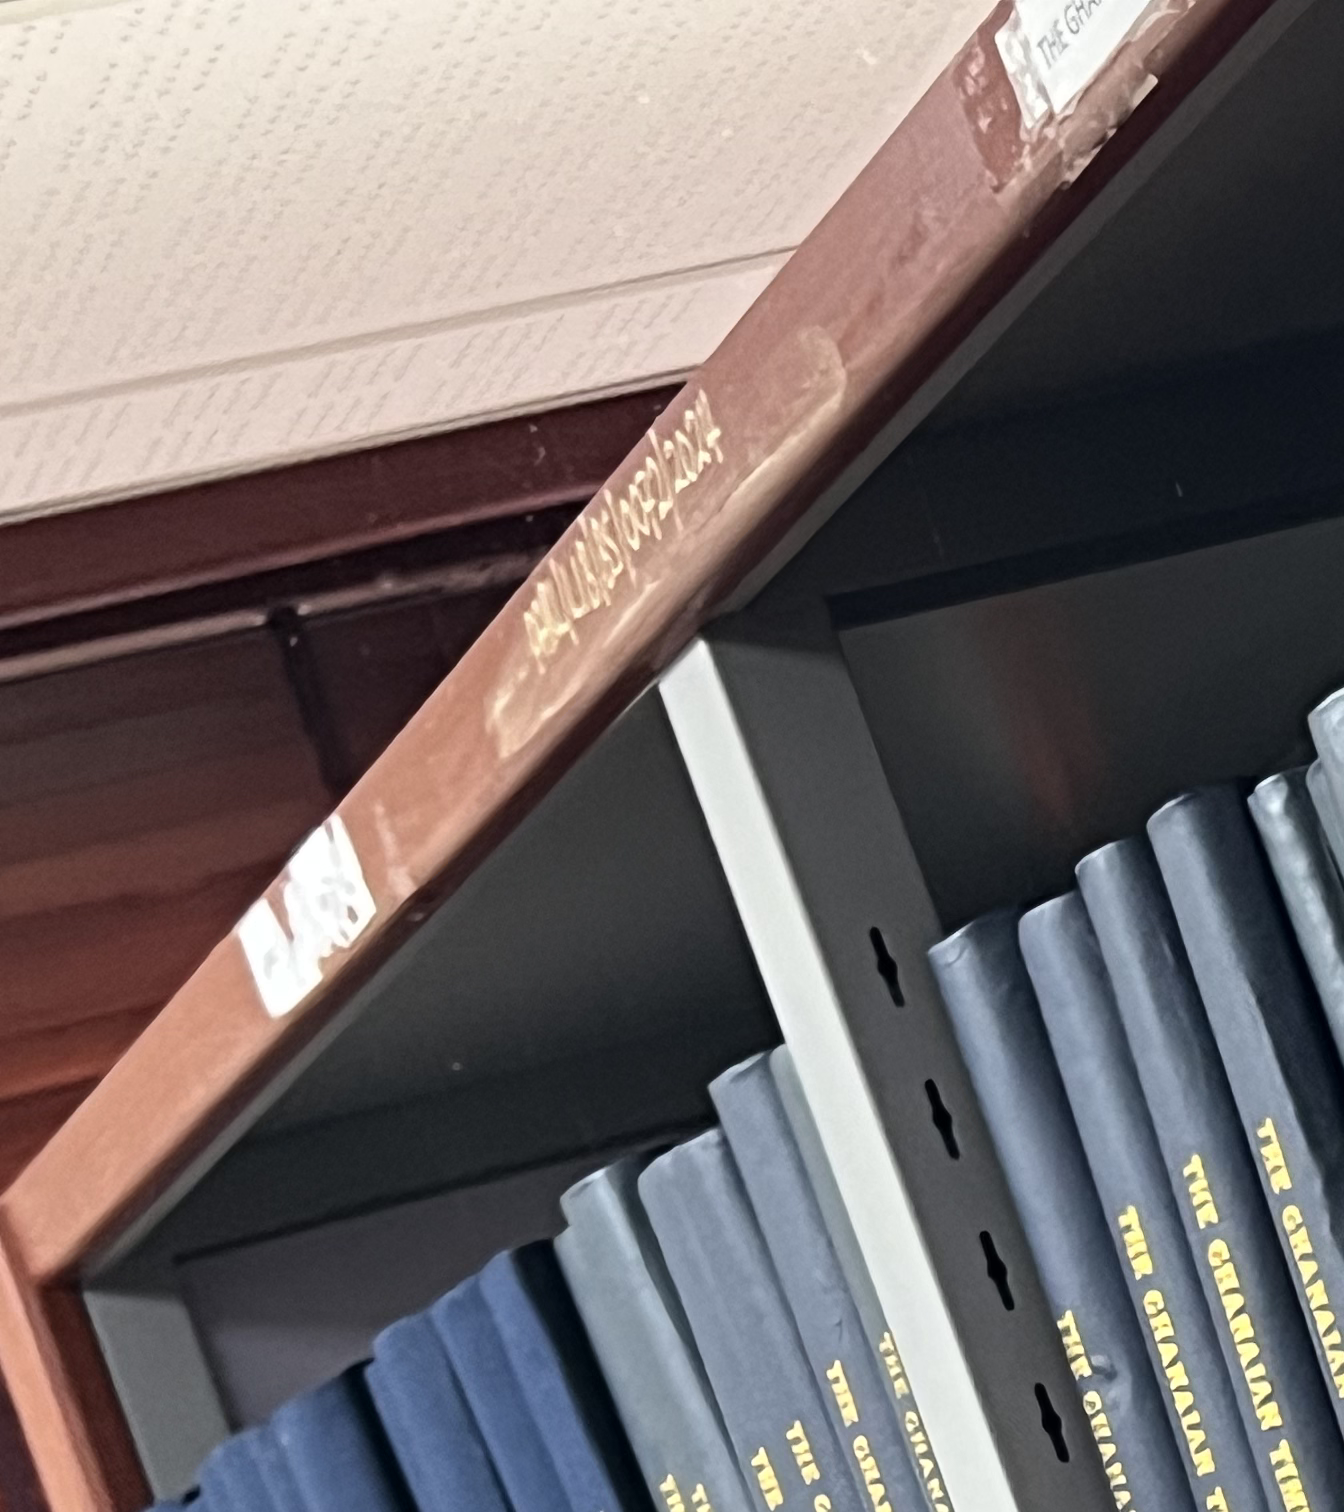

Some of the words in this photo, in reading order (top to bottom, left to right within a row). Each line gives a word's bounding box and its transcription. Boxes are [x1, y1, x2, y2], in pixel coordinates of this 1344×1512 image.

[1256, 1116, 1292, 1194] THE
[1117, 1204, 1154, 1280] THE
[1142, 1288, 1216, 1478] GHANAIAN
[1182, 1153, 1219, 1230] THE
[1207, 1238, 1283, 1432] GHANAIAN
